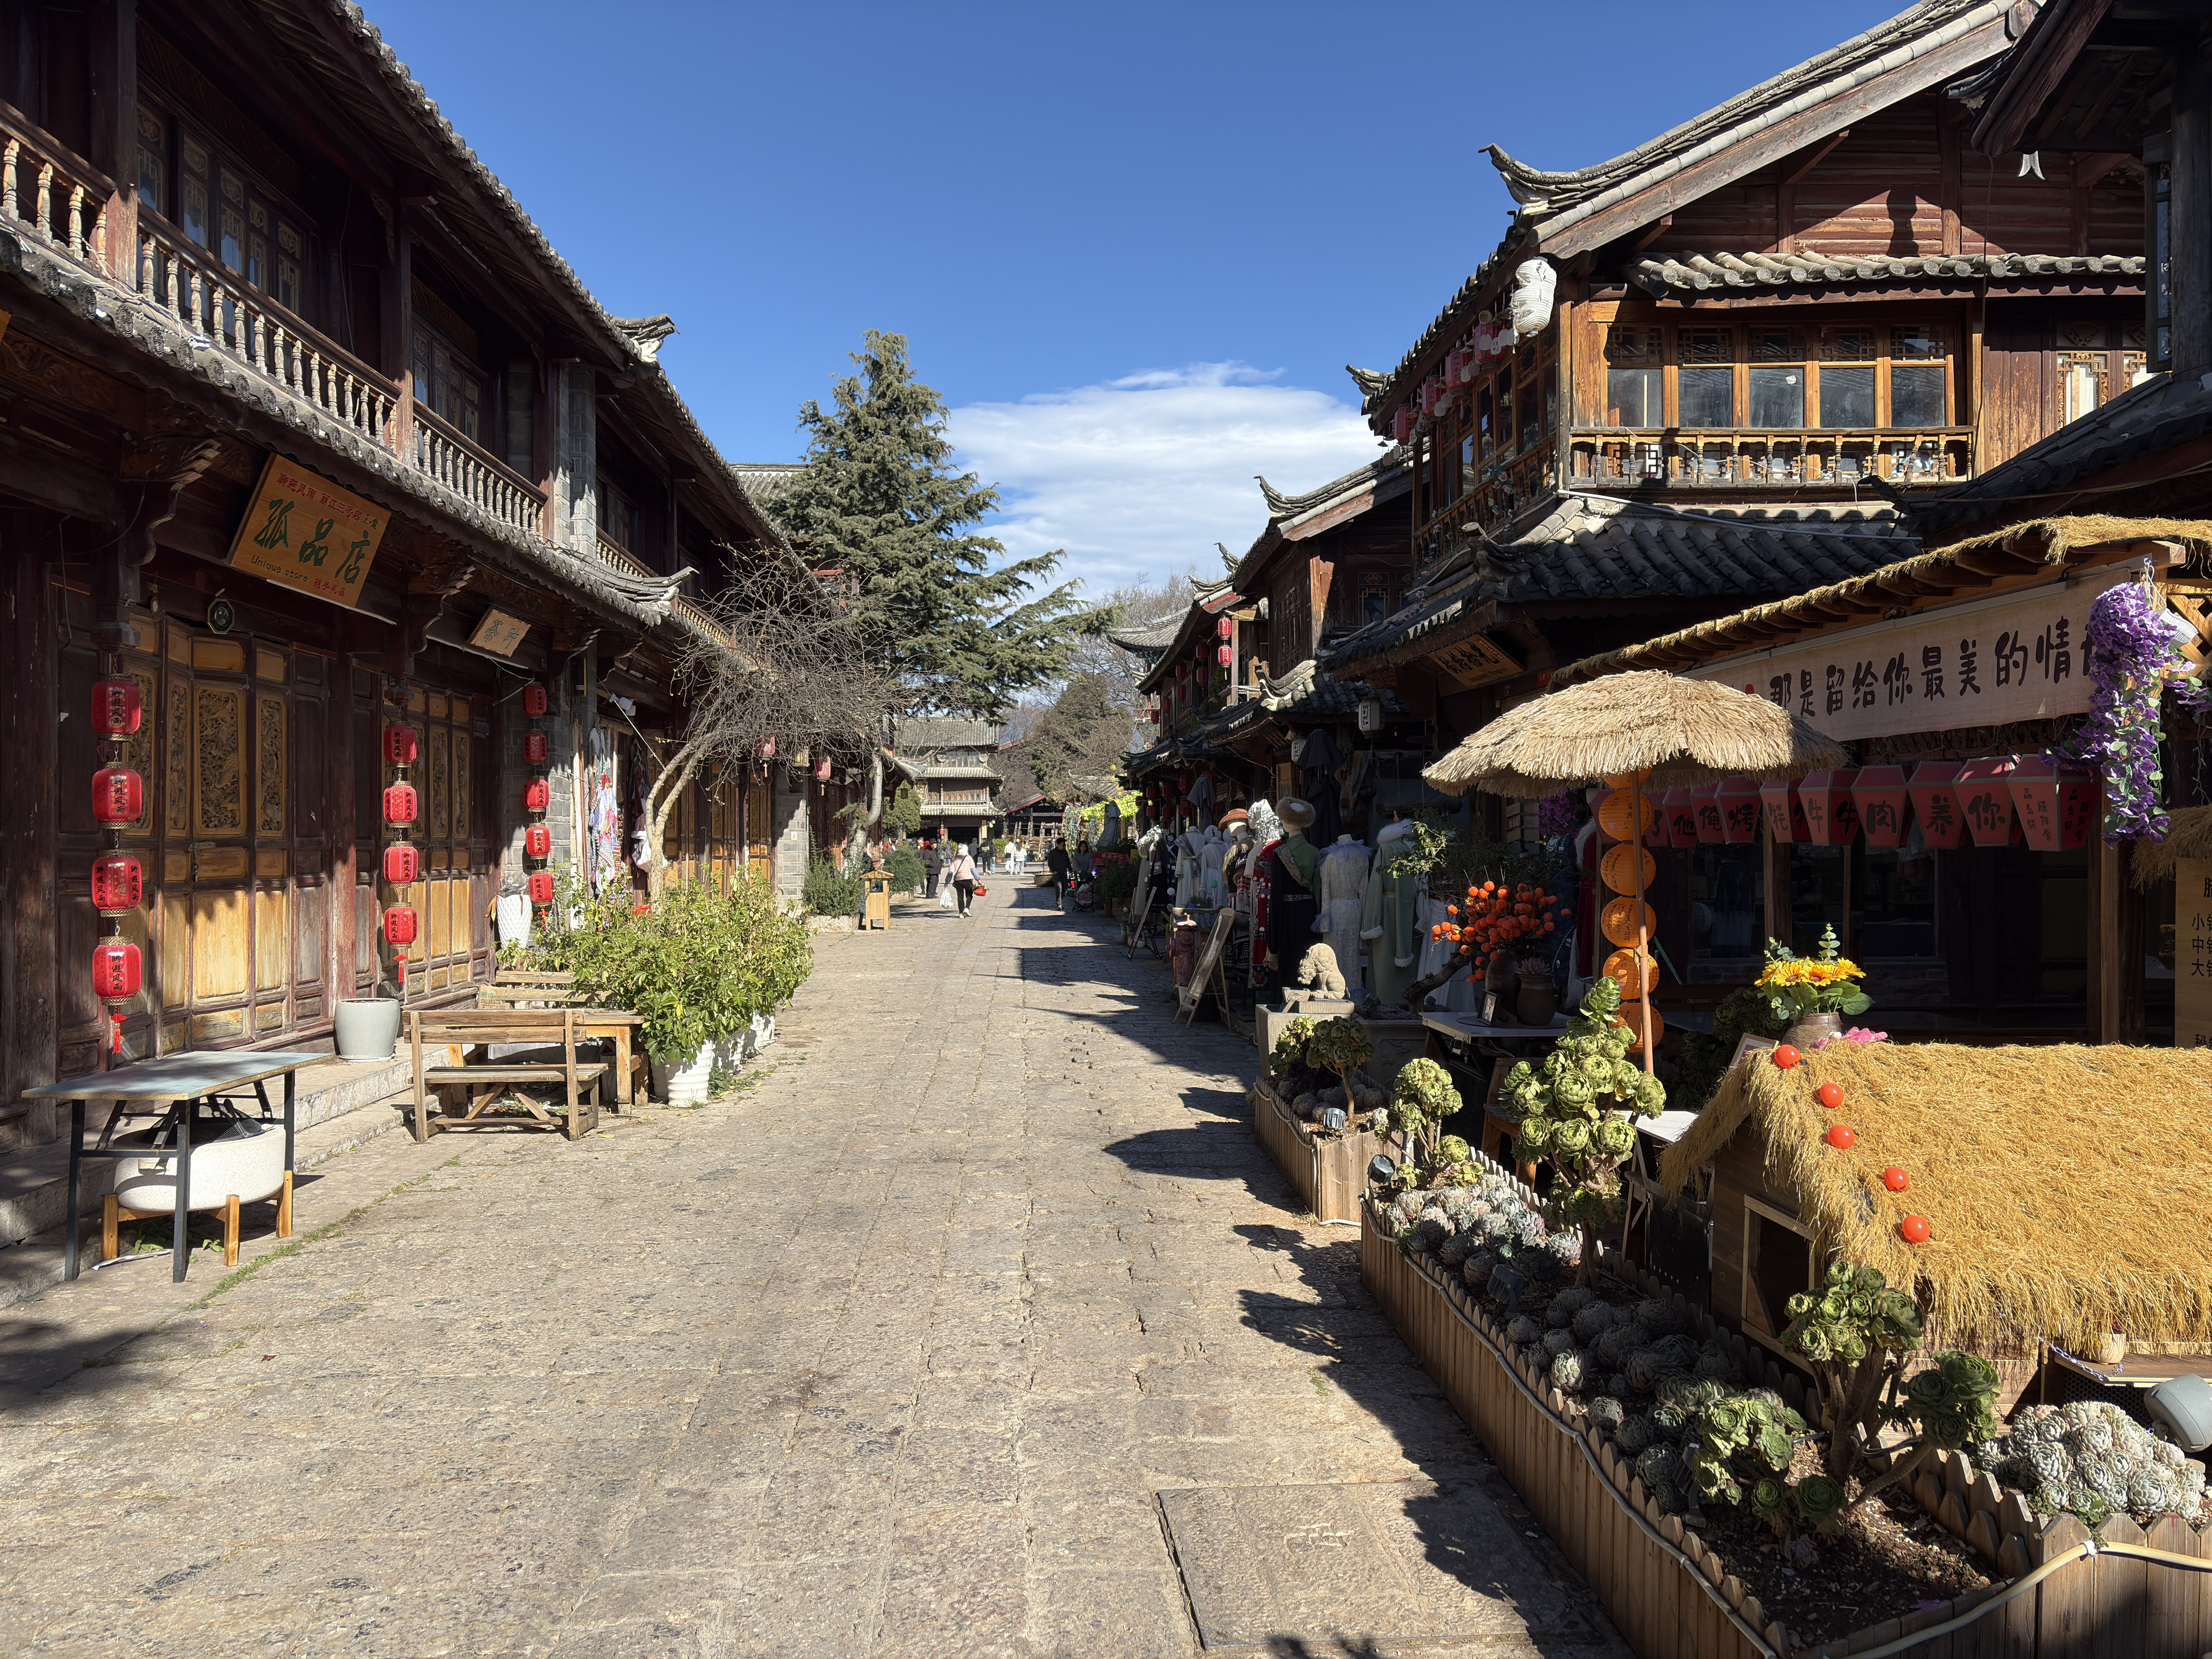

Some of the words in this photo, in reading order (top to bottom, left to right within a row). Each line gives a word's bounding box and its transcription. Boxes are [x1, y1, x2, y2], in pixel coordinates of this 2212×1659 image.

[319, 493, 363, 521] 丽江三号店
[251, 555, 281, 574] Unique
[284, 568, 308, 582] store
[112, 955, 123, 992] 聊避风雨
